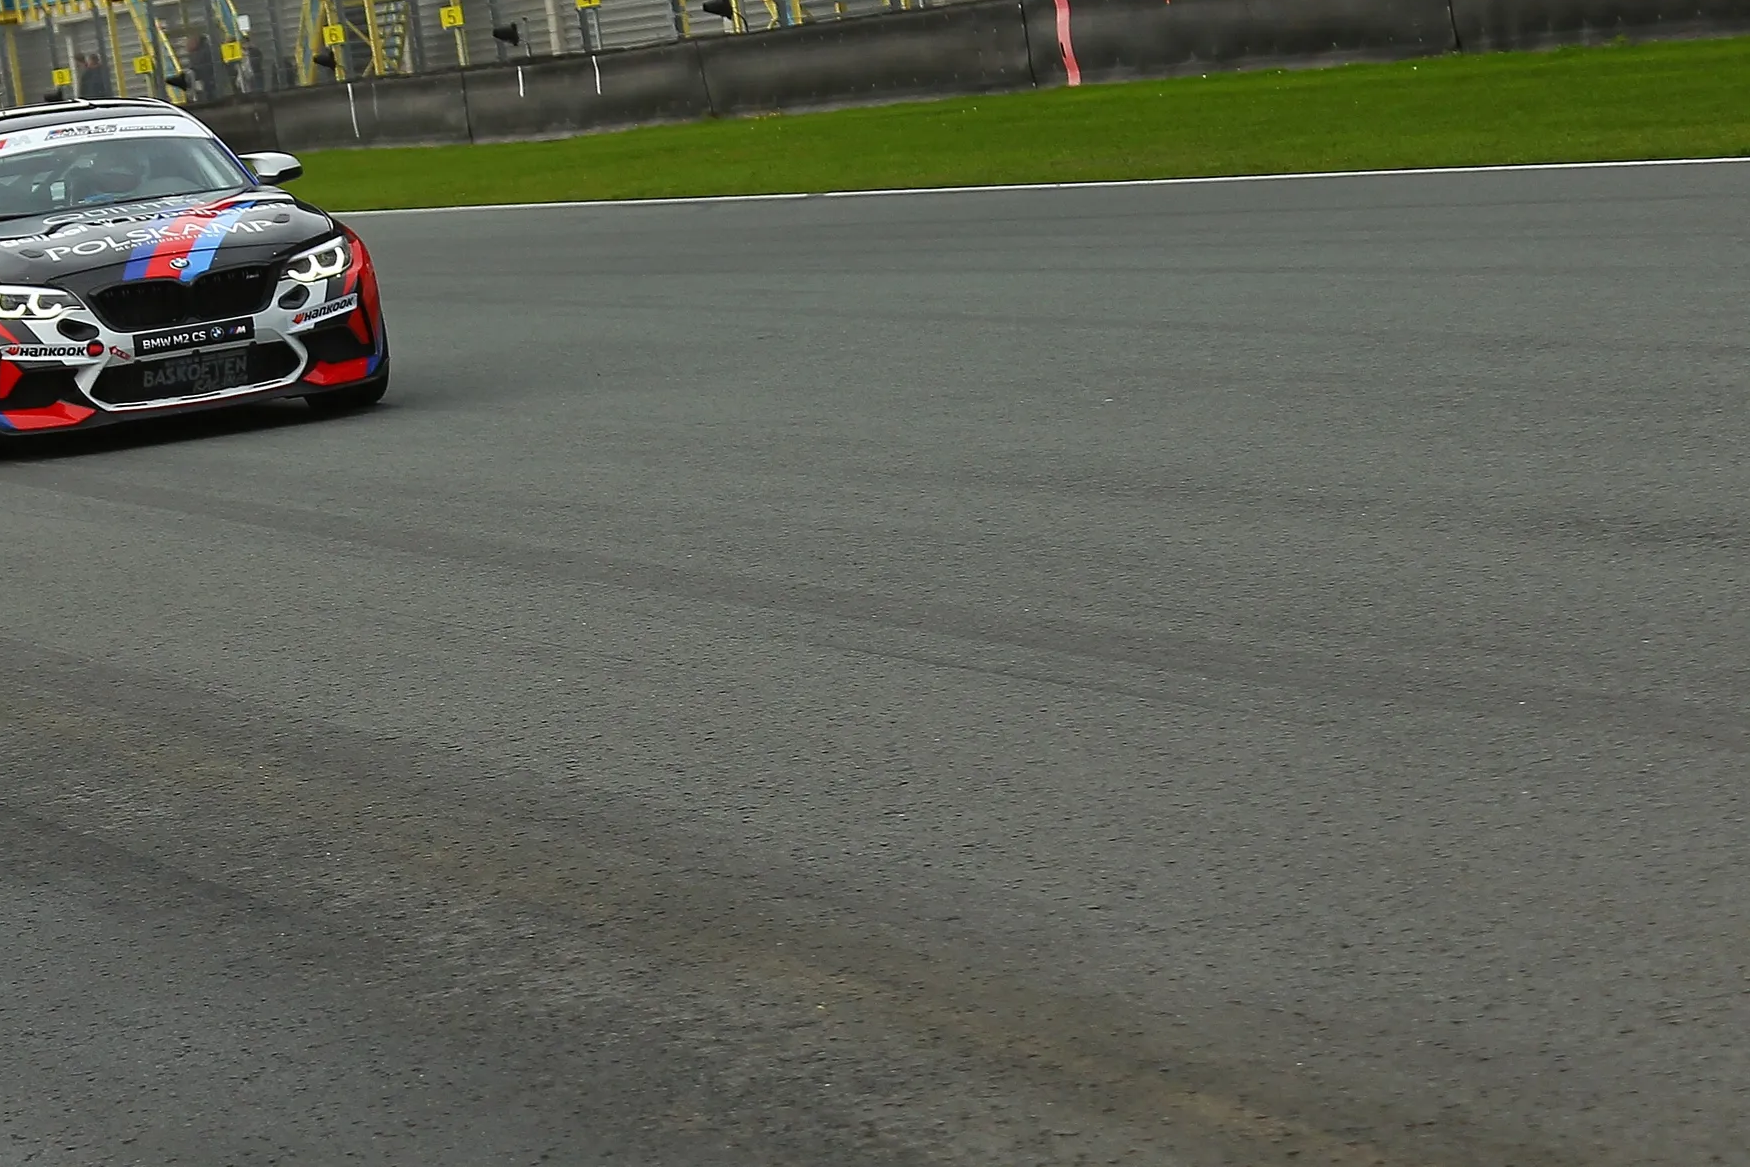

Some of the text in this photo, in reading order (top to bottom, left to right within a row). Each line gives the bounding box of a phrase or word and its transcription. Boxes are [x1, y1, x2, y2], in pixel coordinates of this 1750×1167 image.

[447, 8, 457, 25] 5
[329, 27, 339, 43] 6
[45, 219, 274, 262] POLSKAMP
[143, 331, 207, 350] BMW M2 CS
